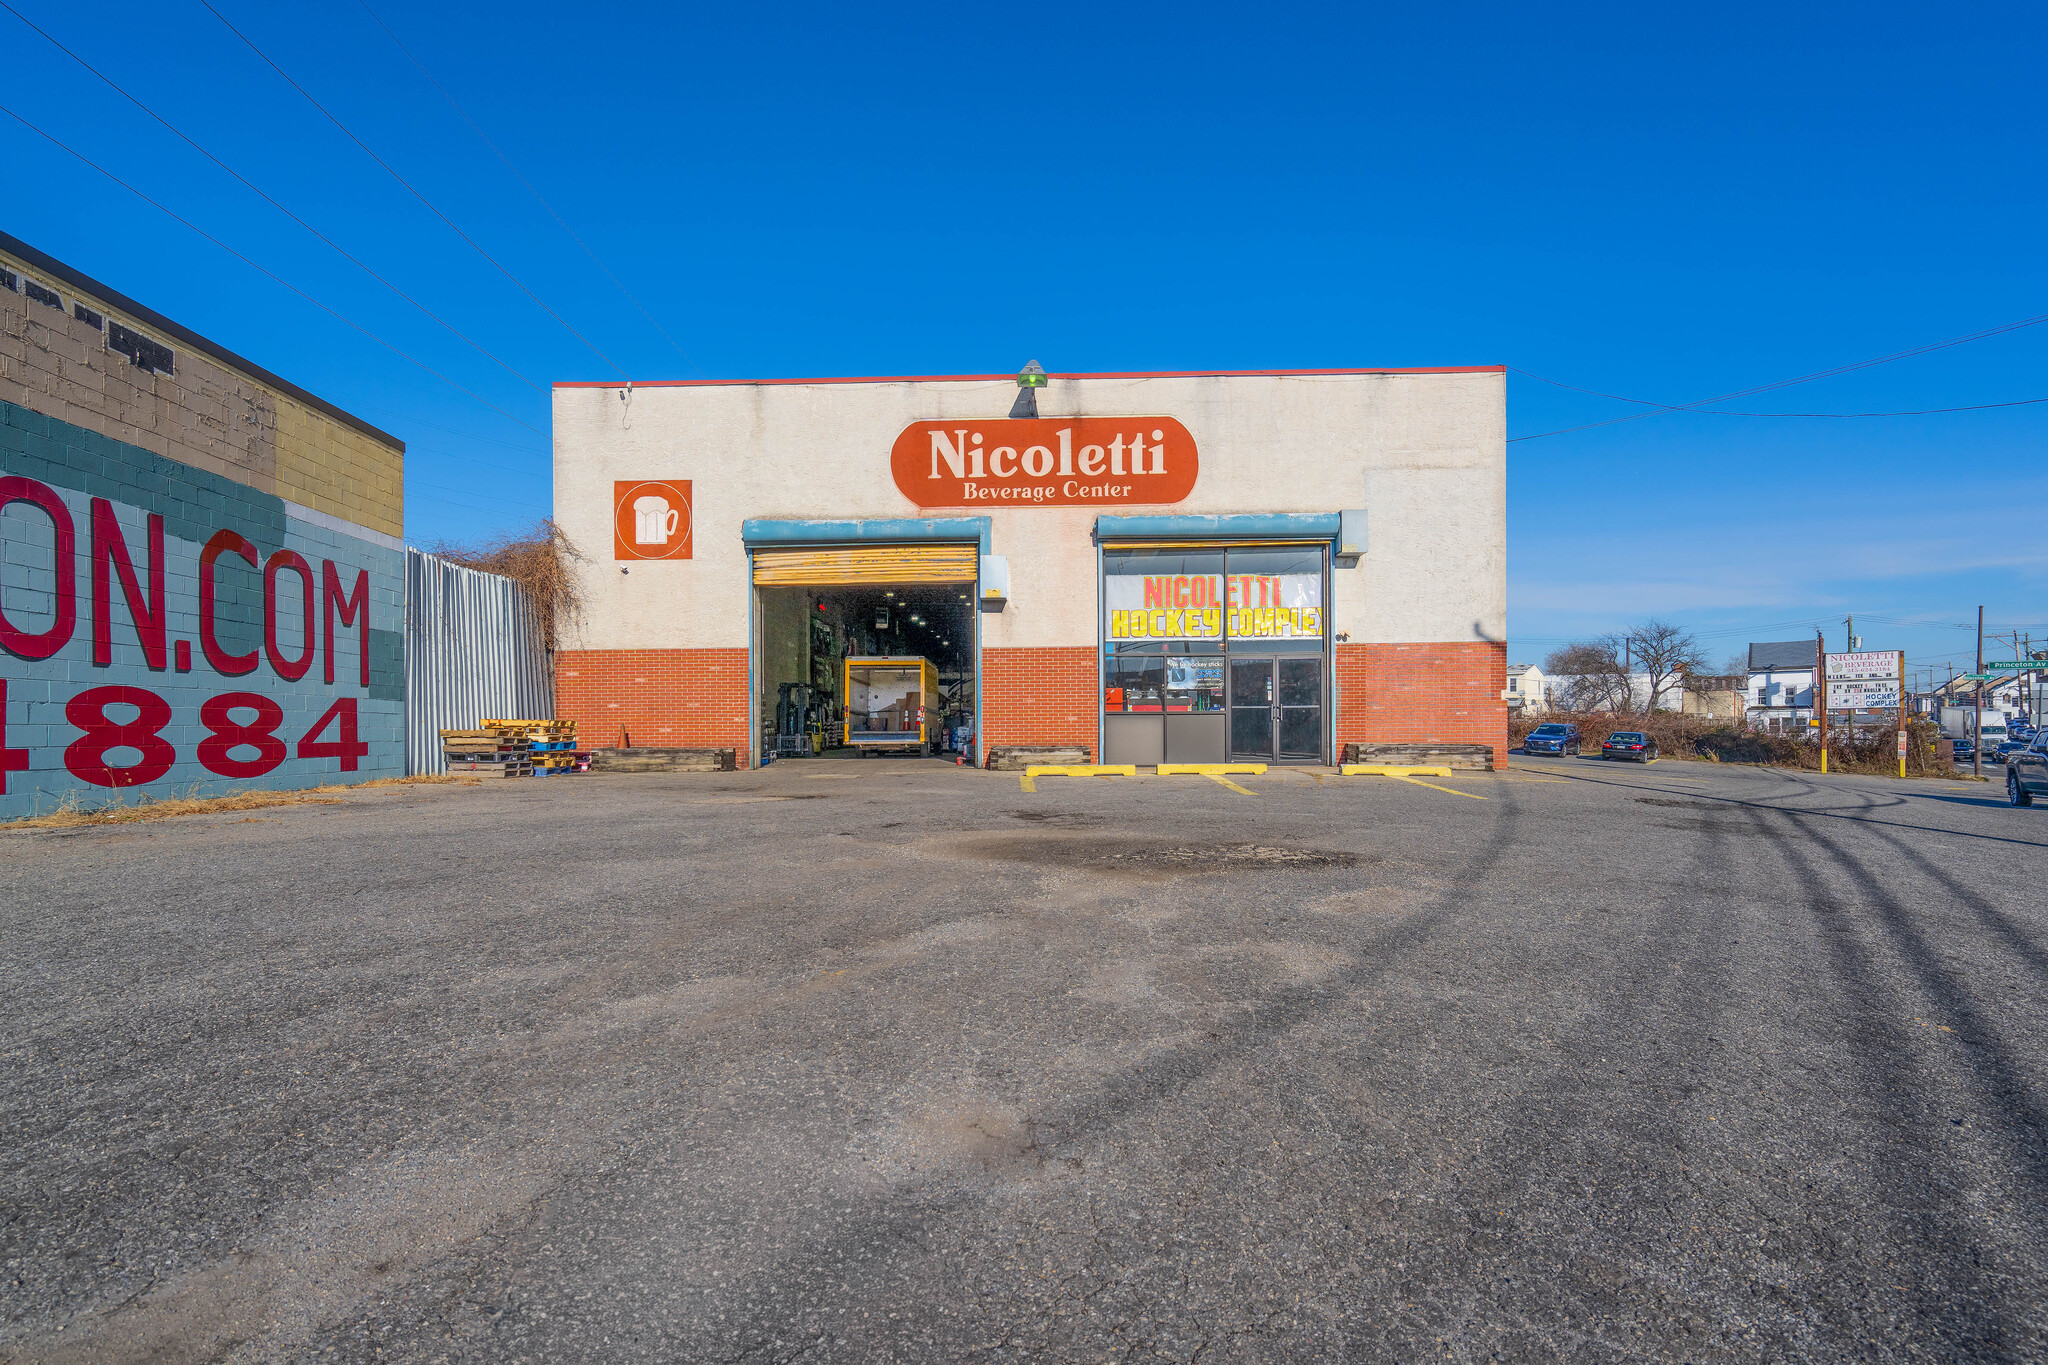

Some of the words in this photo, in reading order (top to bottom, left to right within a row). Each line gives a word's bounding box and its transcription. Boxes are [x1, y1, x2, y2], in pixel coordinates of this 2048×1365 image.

[927, 427, 1168, 479] Nicoletti
[963, 481, 1056, 502] Beverage
[1063, 480, 1132, 498] Center
[0, 475, 370, 688] ON.COM
[1143, 575, 1281, 609] NICOLETTI
[1111, 608, 1221, 638] HOCKEY
[1831, 653, 1894, 662] NICOLETTI
[0, 679, 369, 795] 884
